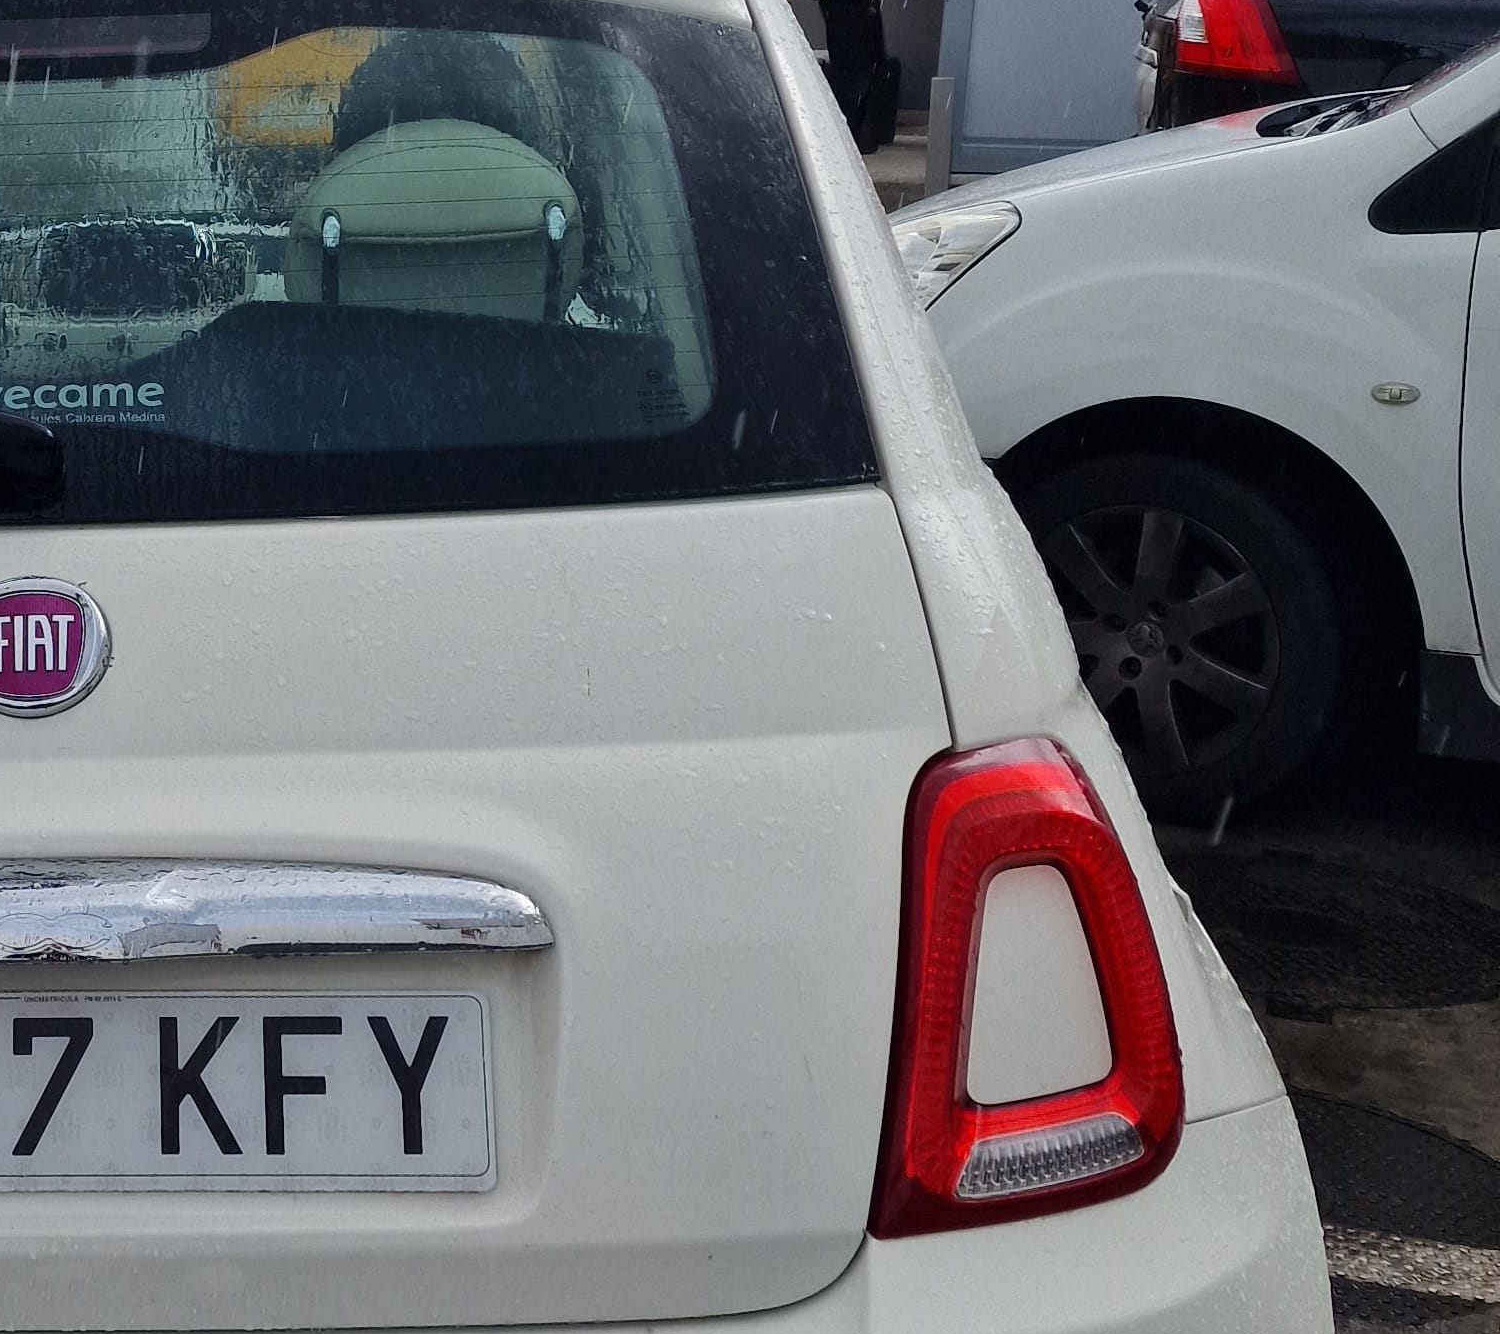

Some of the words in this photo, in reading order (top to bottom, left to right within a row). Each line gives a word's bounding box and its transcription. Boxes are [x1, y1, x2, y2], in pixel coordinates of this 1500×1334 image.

[65, 412, 116, 424] Cabrera
[119, 411, 166, 423] Medina
[158, 1015, 449, 1156] KFY
